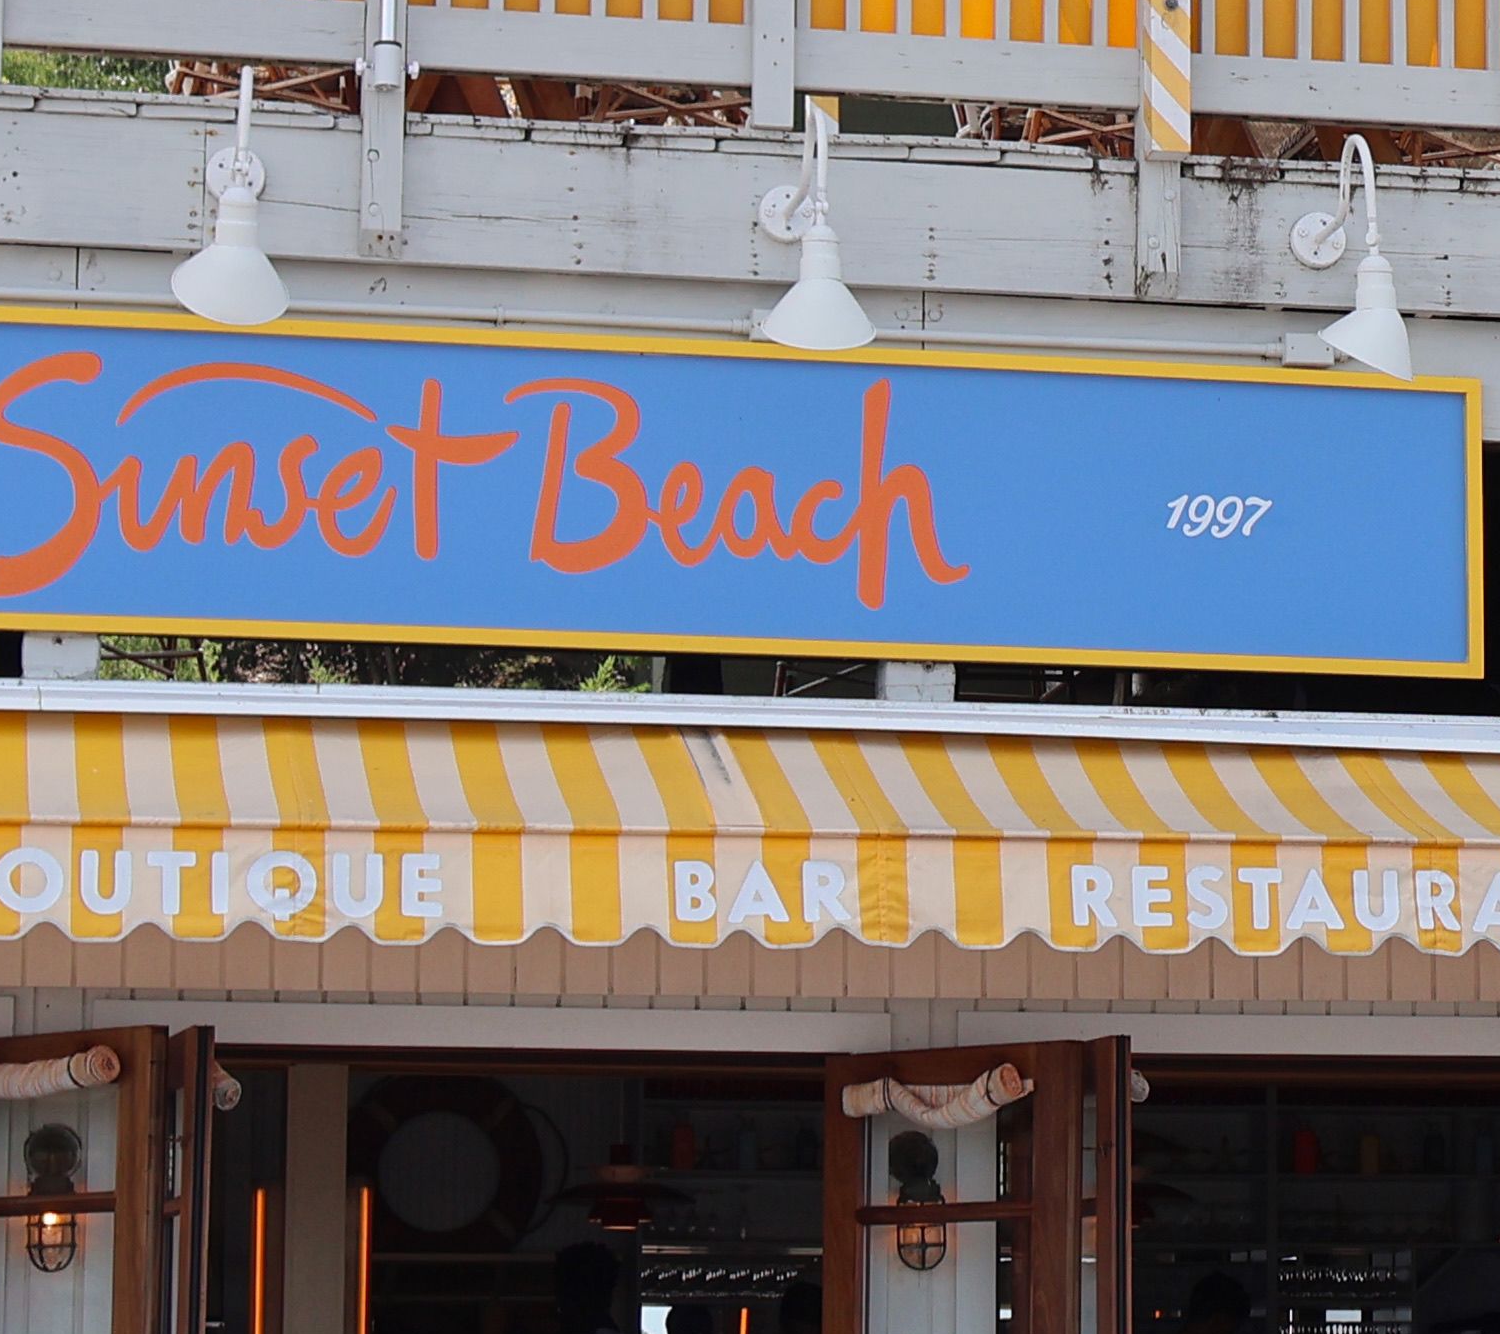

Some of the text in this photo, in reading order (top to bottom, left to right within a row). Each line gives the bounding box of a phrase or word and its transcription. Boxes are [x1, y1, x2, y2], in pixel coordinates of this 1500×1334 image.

[508, 380, 970, 609] Beach
[1167, 494, 1273, 539] 1997
[674, 858, 853, 930] BAR
